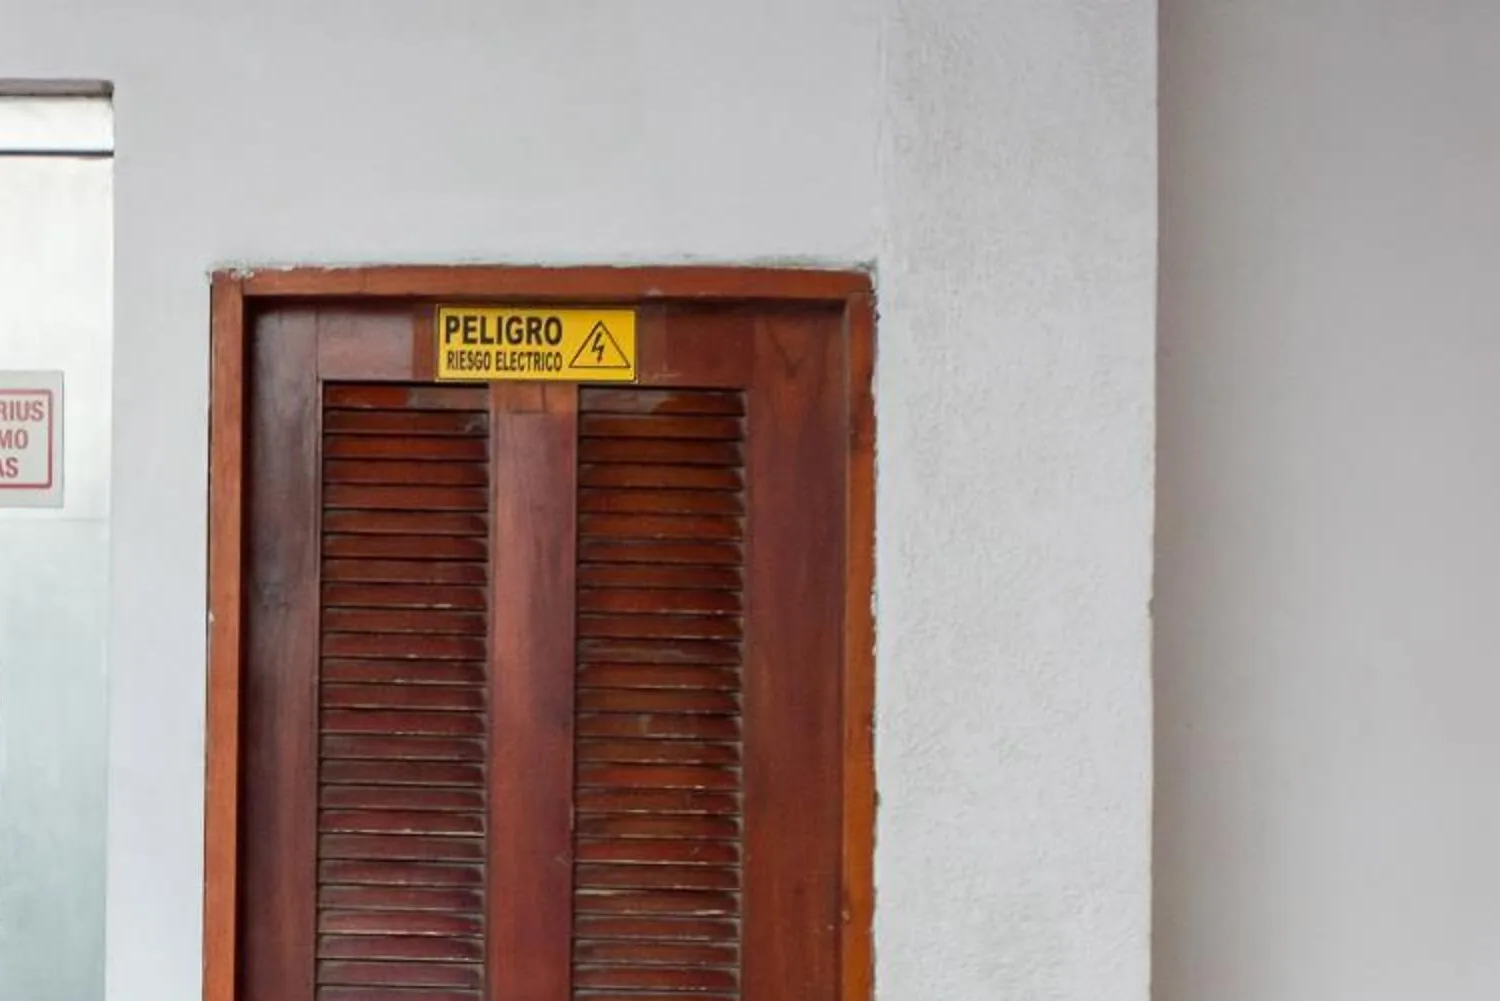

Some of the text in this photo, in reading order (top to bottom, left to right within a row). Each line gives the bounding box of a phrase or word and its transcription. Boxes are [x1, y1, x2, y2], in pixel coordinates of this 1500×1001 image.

[445, 315, 563, 345] PELIGRO
[447, 351, 563, 371] RIESGO ELECTRICO
